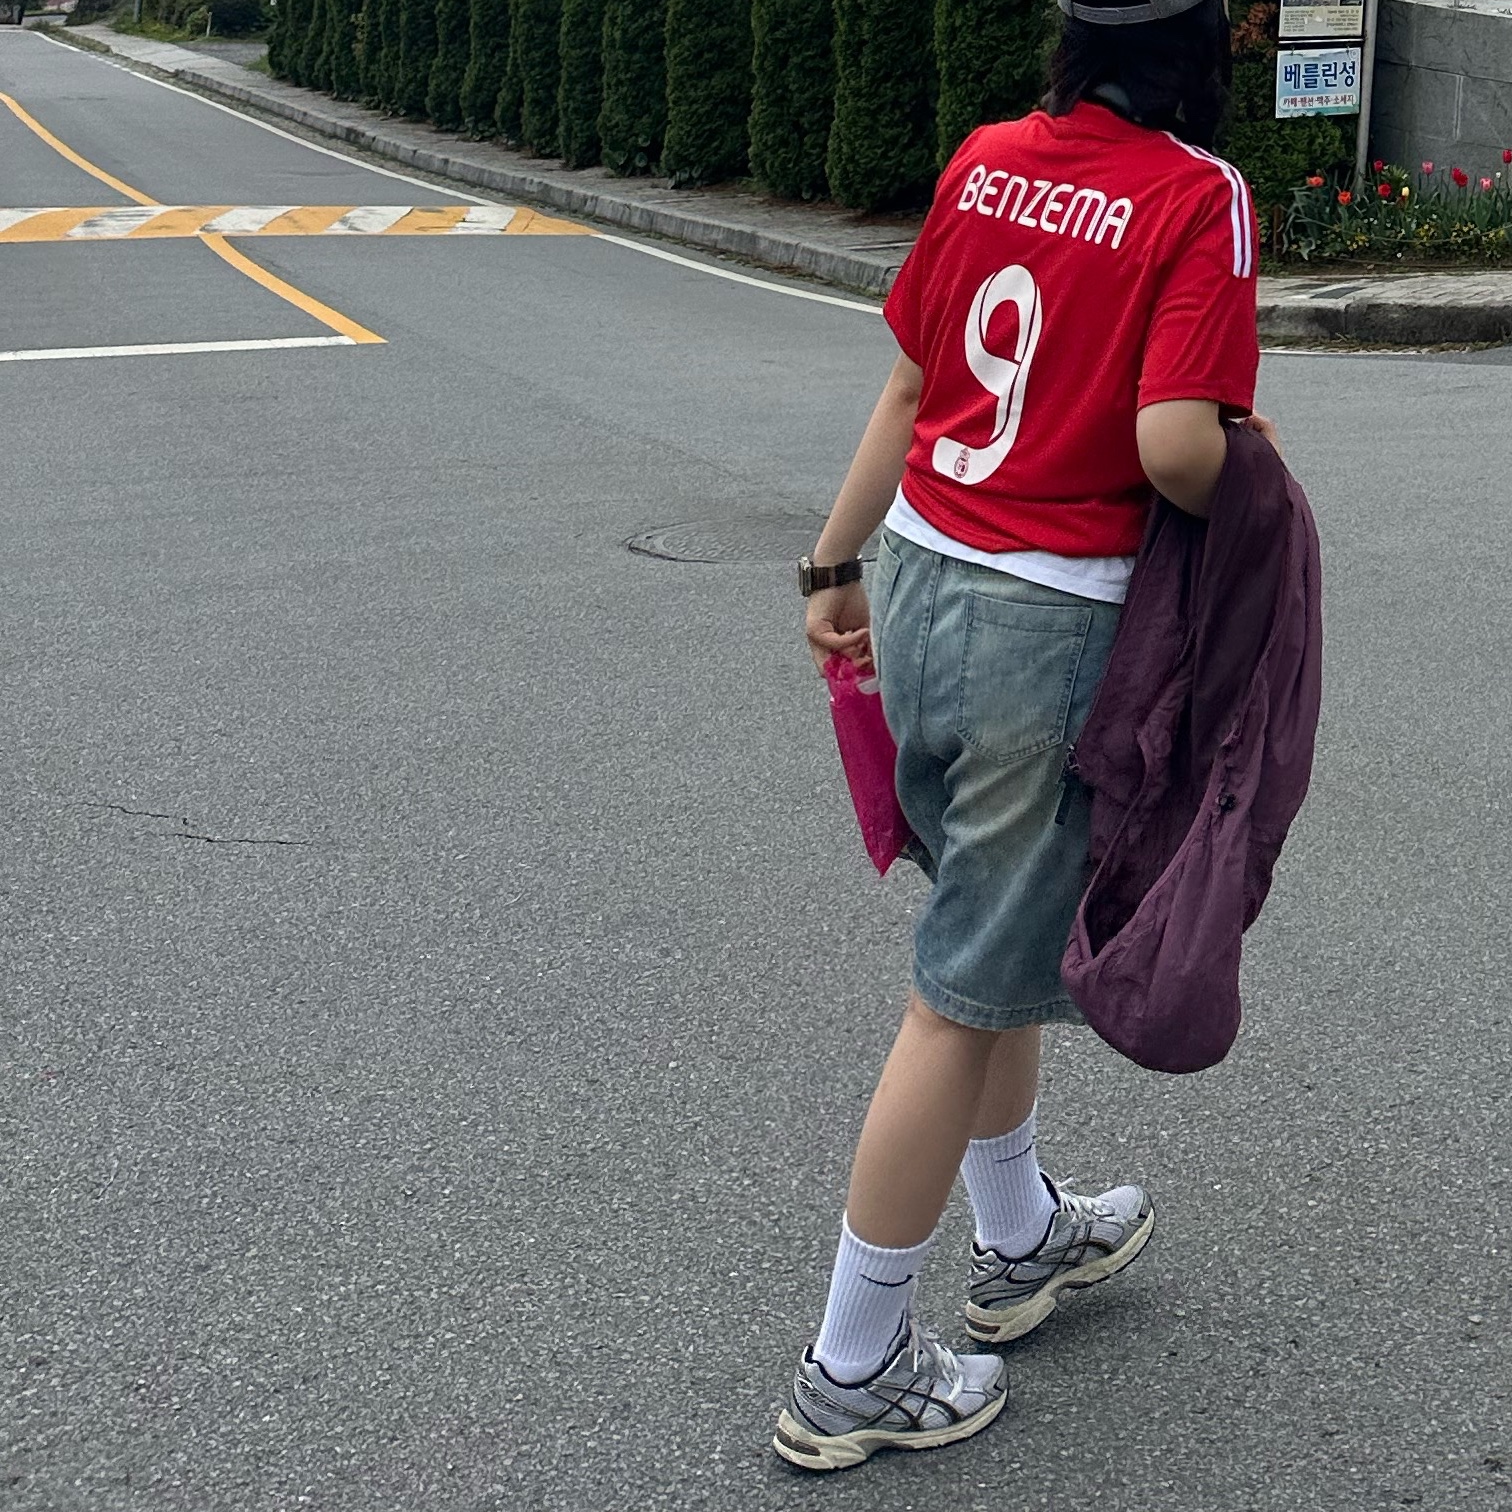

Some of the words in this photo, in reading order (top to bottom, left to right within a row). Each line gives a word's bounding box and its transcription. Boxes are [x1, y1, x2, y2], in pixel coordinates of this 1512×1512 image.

[1284, 61, 1356, 89] 베를린성
[957, 164, 1134, 250] BENZEMA
[931, 264, 1043, 486] 9
